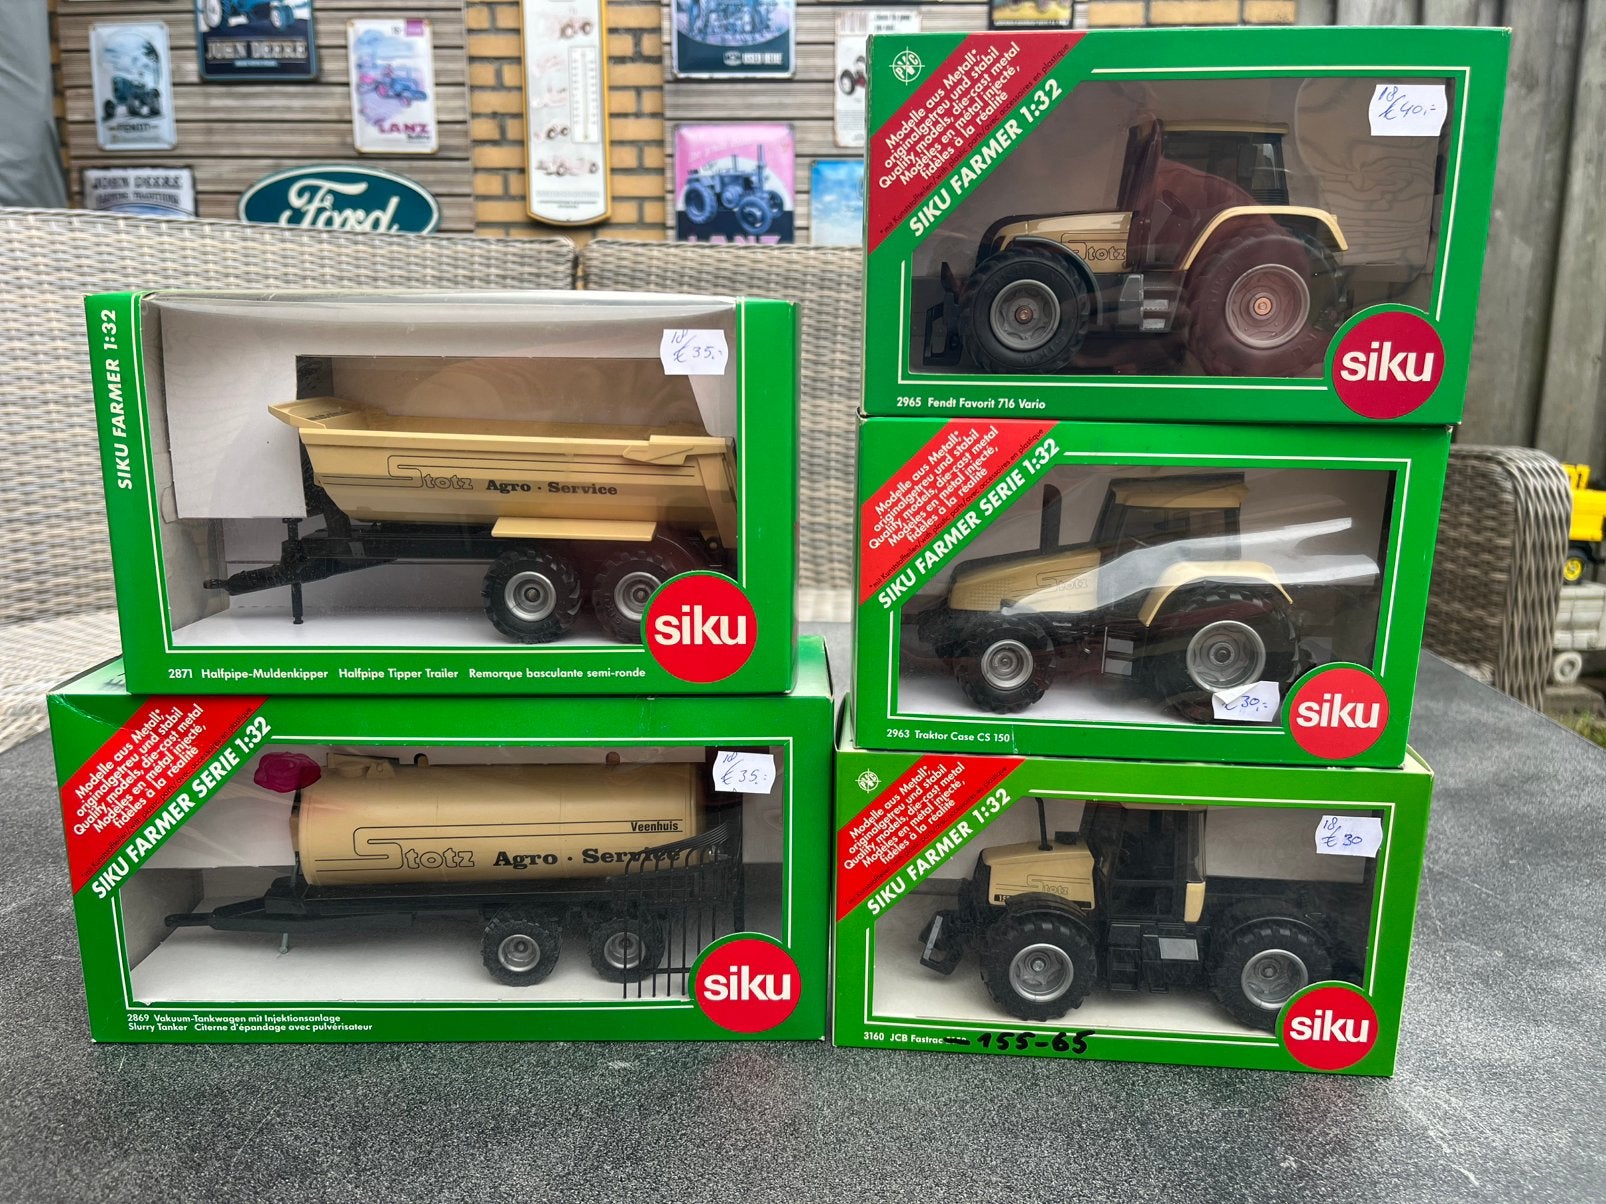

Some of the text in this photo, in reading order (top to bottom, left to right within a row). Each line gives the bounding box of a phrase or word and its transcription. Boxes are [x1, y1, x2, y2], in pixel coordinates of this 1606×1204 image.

[379, 123, 430, 134] LANZ
[879, 152, 916, 188] Quality
[953, 74, 991, 115] die-cast
[991, 42, 1020, 75] metal
[885, 46, 999, 168] originalgetreu und stabil
[885, 109, 926, 149] Modelle
[926, 90, 945, 108] aus
[920, 91, 1008, 180] fidèles à la réalité
[900, 144, 941, 185] Modèles
[942, 129, 955, 143] en
[955, 99, 984, 129] métal
[909, 79, 1062, 236] SIKU FARMER 1:32
[278, 178, 400, 233] Ford
[1340, 341, 1434, 382] siku
[101, 309, 133, 490] SIKU FARMER 1:32
[896, 397, 1046, 409] 2965 Fendt Favorit 716 Vario
[387, 455, 618, 495] Stotz Agro Service
[869, 518, 903, 549] Quality
[936, 452, 972, 488] die-cast
[972, 425, 999, 455] metal
[874, 429, 979, 532] originalgetreu und stabil
[875, 480, 911, 515] Modelle
[912, 465, 929, 481] aus
[907, 467, 988, 543] fidèles à la réalité
[878, 438, 1060, 609] SIKU FARMER SERIE 1:32
[888, 511, 926, 546] Modèles
[926, 499, 939, 511] en
[939, 473, 965, 500] métal
[654, 604, 747, 645] siku
[168, 666, 646, 681] 2871 Halfpipe-Muldenkipper Halfpipe Tipper Trailer Remorque basculante semi-ronde
[886, 729, 1010, 742] 2963 Traktor Case CS 150
[1296, 693, 1380, 729] siku
[74, 803, 107, 835] Quality
[142, 733, 179, 769] die-cast
[178, 703, 204, 733] metal
[75, 762, 114, 799] Modelle
[114, 744, 133, 762] aus
[77, 707, 183, 817] originalgetreu und stabil
[113, 746, 199, 828] fidèles à la réalité
[91, 717, 271, 899] SIKU FARMER SERIE 1:32
[93, 795, 133, 832] Modèles
[133, 782, 146, 795] en
[146, 755, 174, 783] métal
[844, 842, 876, 870] Quality
[907, 784, 941, 815] die-cast
[940, 761, 965, 787] metal
[848, 804, 905, 854] originalgetreu
[905, 787, 923, 803] und
[923, 764, 947, 788] stabil
[849, 808, 884, 839] Modelle
[885, 795, 900, 809] aus
[353, 826, 476, 870] Stotz
[493, 851, 559, 870] Agro
[630, 820, 679, 832] Veenhuis
[861, 836, 898, 868] Modèles
[898, 825, 910, 837] en
[910, 802, 935, 826] métal
[867, 876, 906, 914] SIKU
[907, 821, 973, 881] FARMER
[972, 788, 1011, 823] 1:32
[879, 840, 909, 864] fidèles
[909, 832, 917, 841] à
[917, 825, 927, 834] la
[928, 798, 955, 824] réalité
[703, 965, 791, 1001] siku
[127, 1013, 341, 1024] 2869 Vakuum-Tankwagen mit Injektionsanlage
[128, 1022, 155, 1032] Slurry
[157, 1022, 188, 1031] Tanker
[194, 1022, 228, 1031] Citerne
[312, 1022, 373, 1033] pulvérisateur
[863, 1031, 885, 1041] 3160
[889, 1033, 908, 1042] JCB
[910, 1034, 943, 1044] Fastrac
[977, 1030, 1096, 1054] 155-65
[1289, 1009, 1370, 1043] siku
